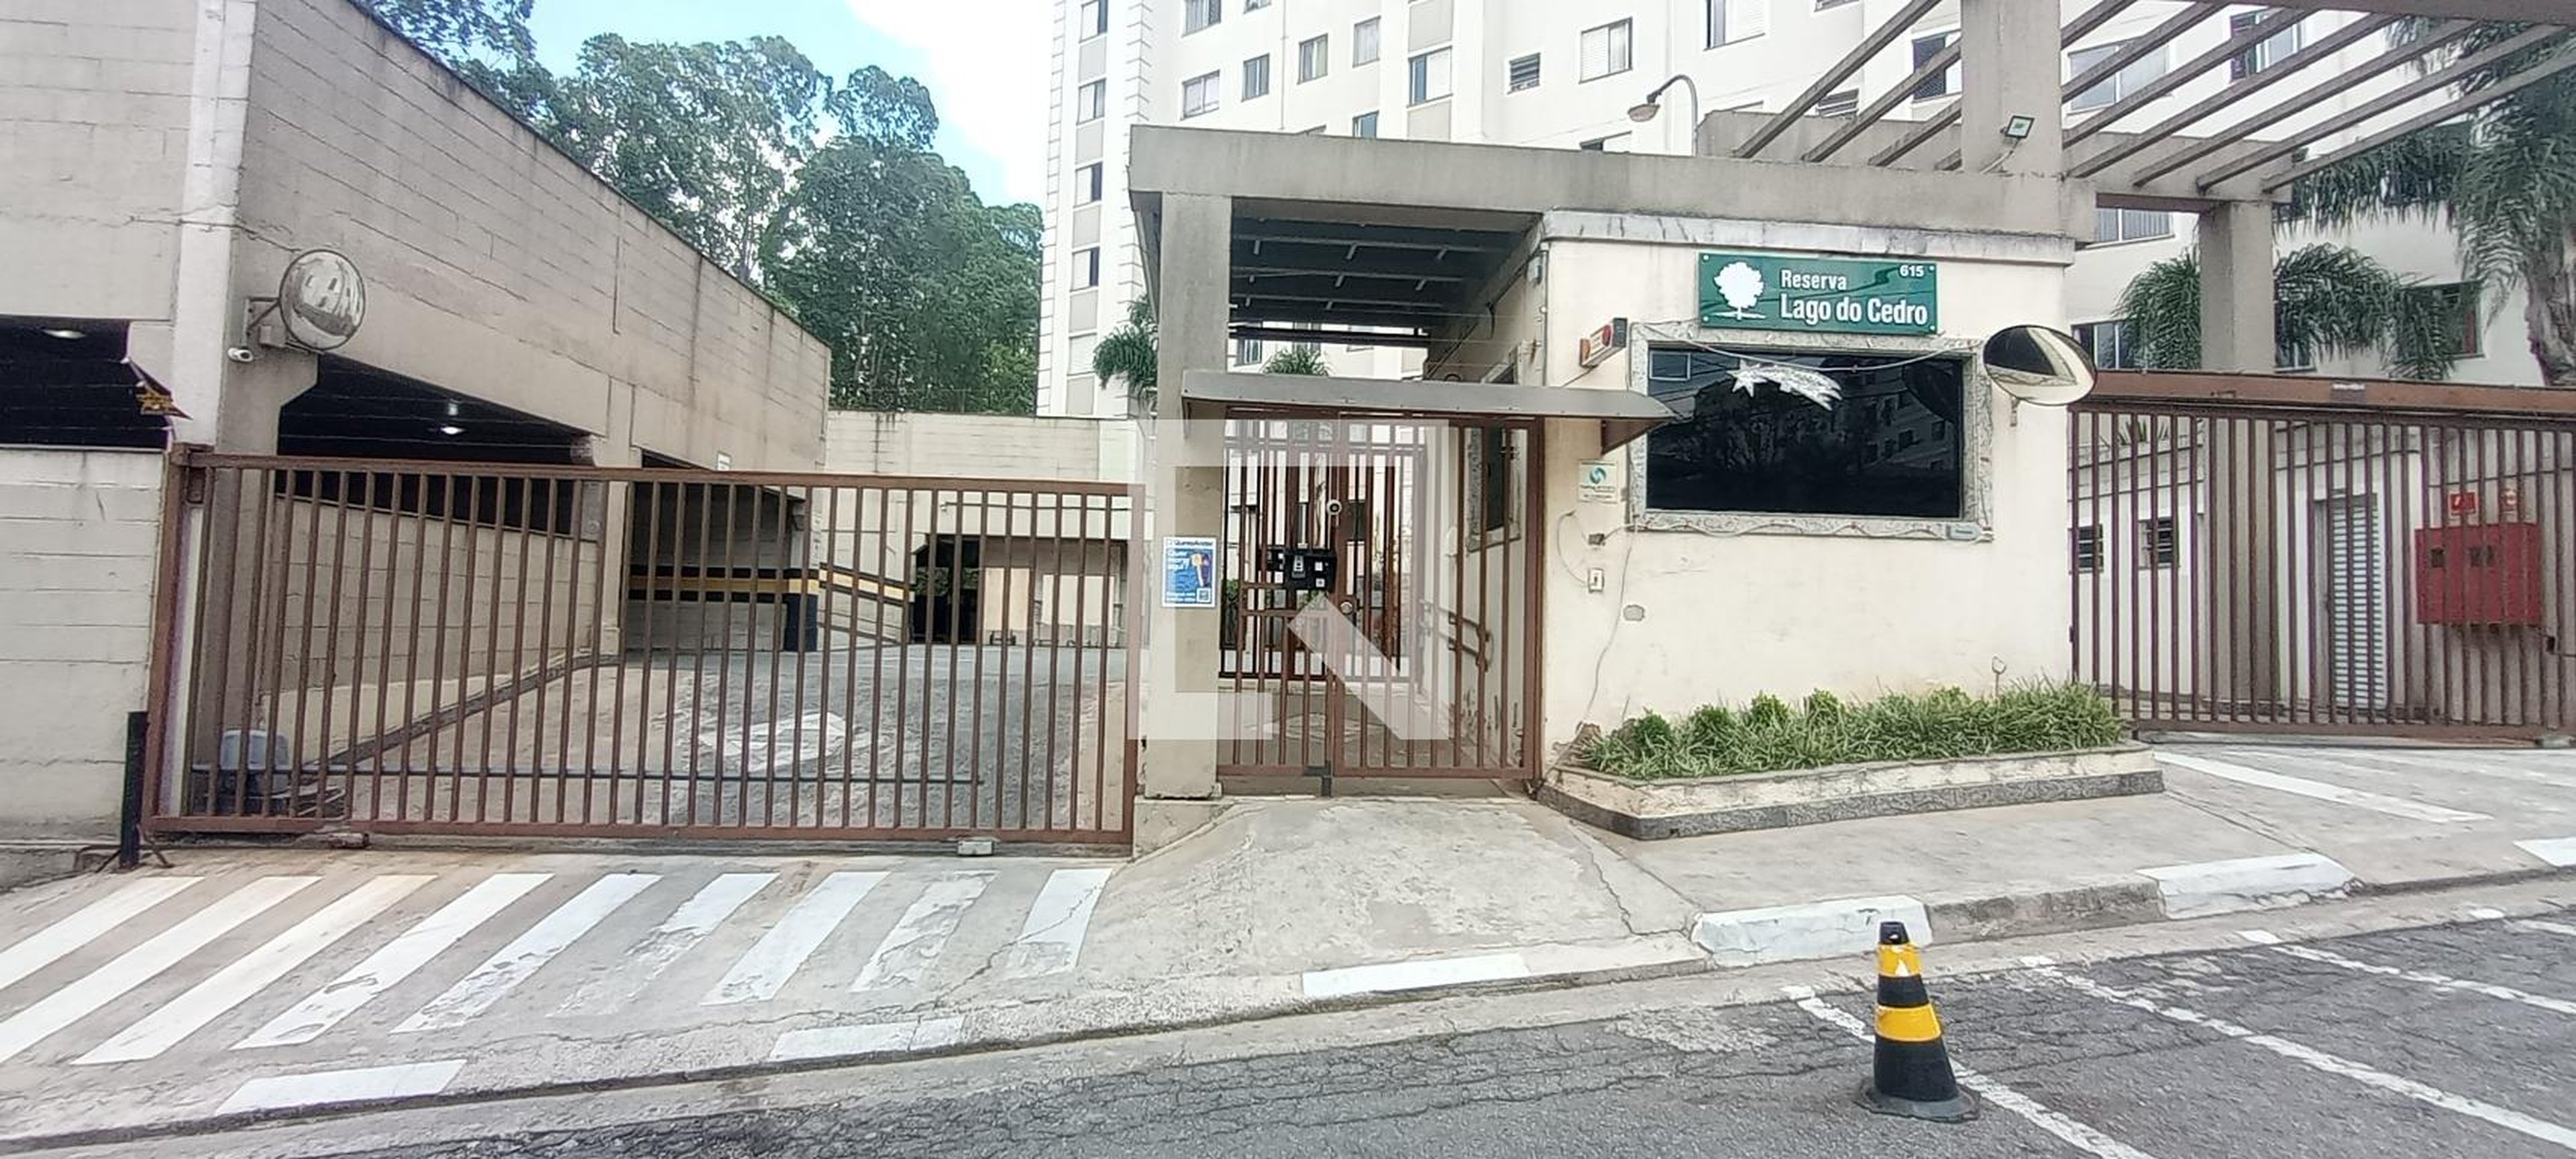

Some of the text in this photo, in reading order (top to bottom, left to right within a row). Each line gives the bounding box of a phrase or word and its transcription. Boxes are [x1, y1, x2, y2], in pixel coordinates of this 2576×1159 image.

[1781, 269, 1847, 290] Reserva
[1900, 264, 1925, 277] 615
[1781, 293, 1928, 325] Lago do Cedro
